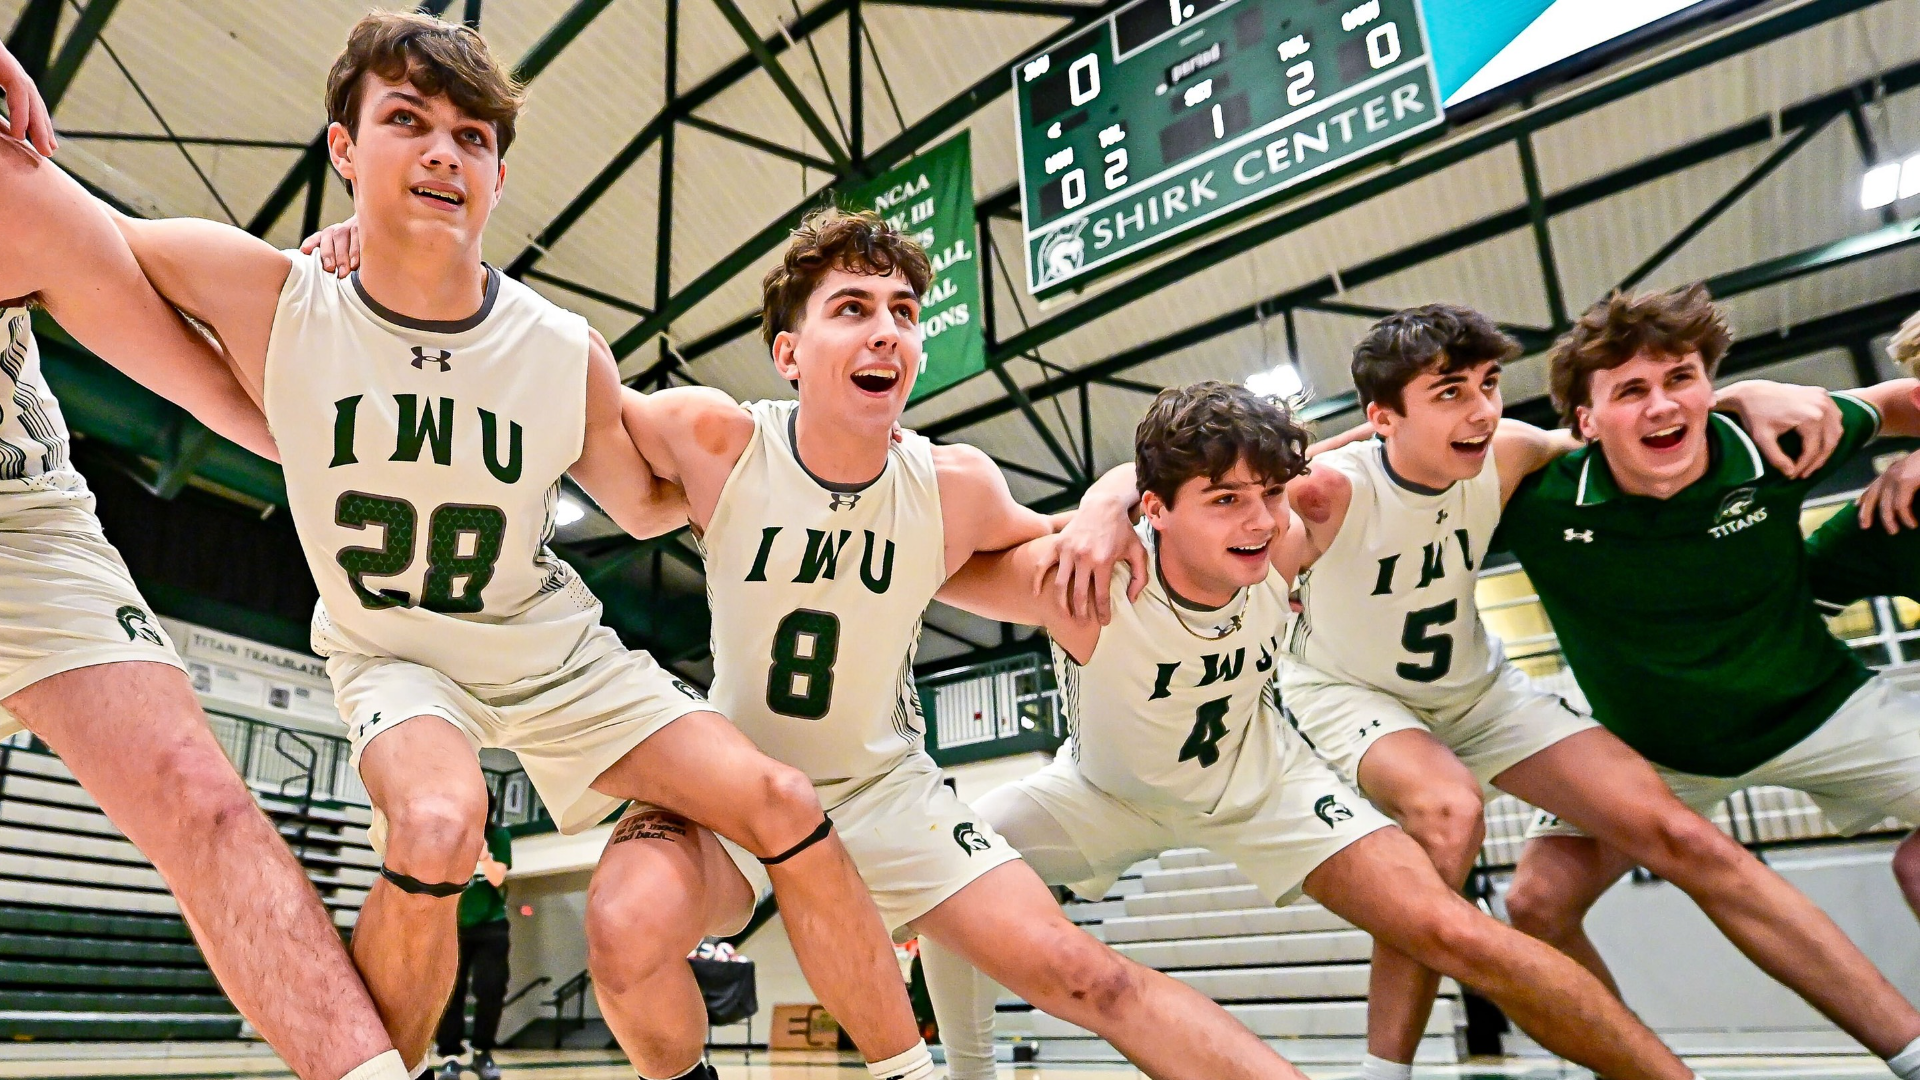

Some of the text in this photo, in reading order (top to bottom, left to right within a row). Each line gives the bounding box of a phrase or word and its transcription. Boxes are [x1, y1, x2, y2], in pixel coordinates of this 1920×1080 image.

[1366, 21, 1401, 70] 0
[1068, 52, 1101, 107] 0
[1285, 60, 1316, 107] 2
[1061, 167, 1087, 210] 0
[1092, 82, 1425, 250] SHIRK CENTER
[1104, 147, 1128, 191] 2
[874, 173, 930, 214] NCAA
[910, 196, 935, 225] III
[1707, 506, 1768, 539] TITANS
[335, 490, 507, 613] 28
[194, 633, 238, 655] TITAN
[245, 647, 329, 679] TRAILBLAZE
[766, 607, 841, 721] 8
[1395, 598, 1458, 683] 5
[1178, 694, 1233, 769] 4
